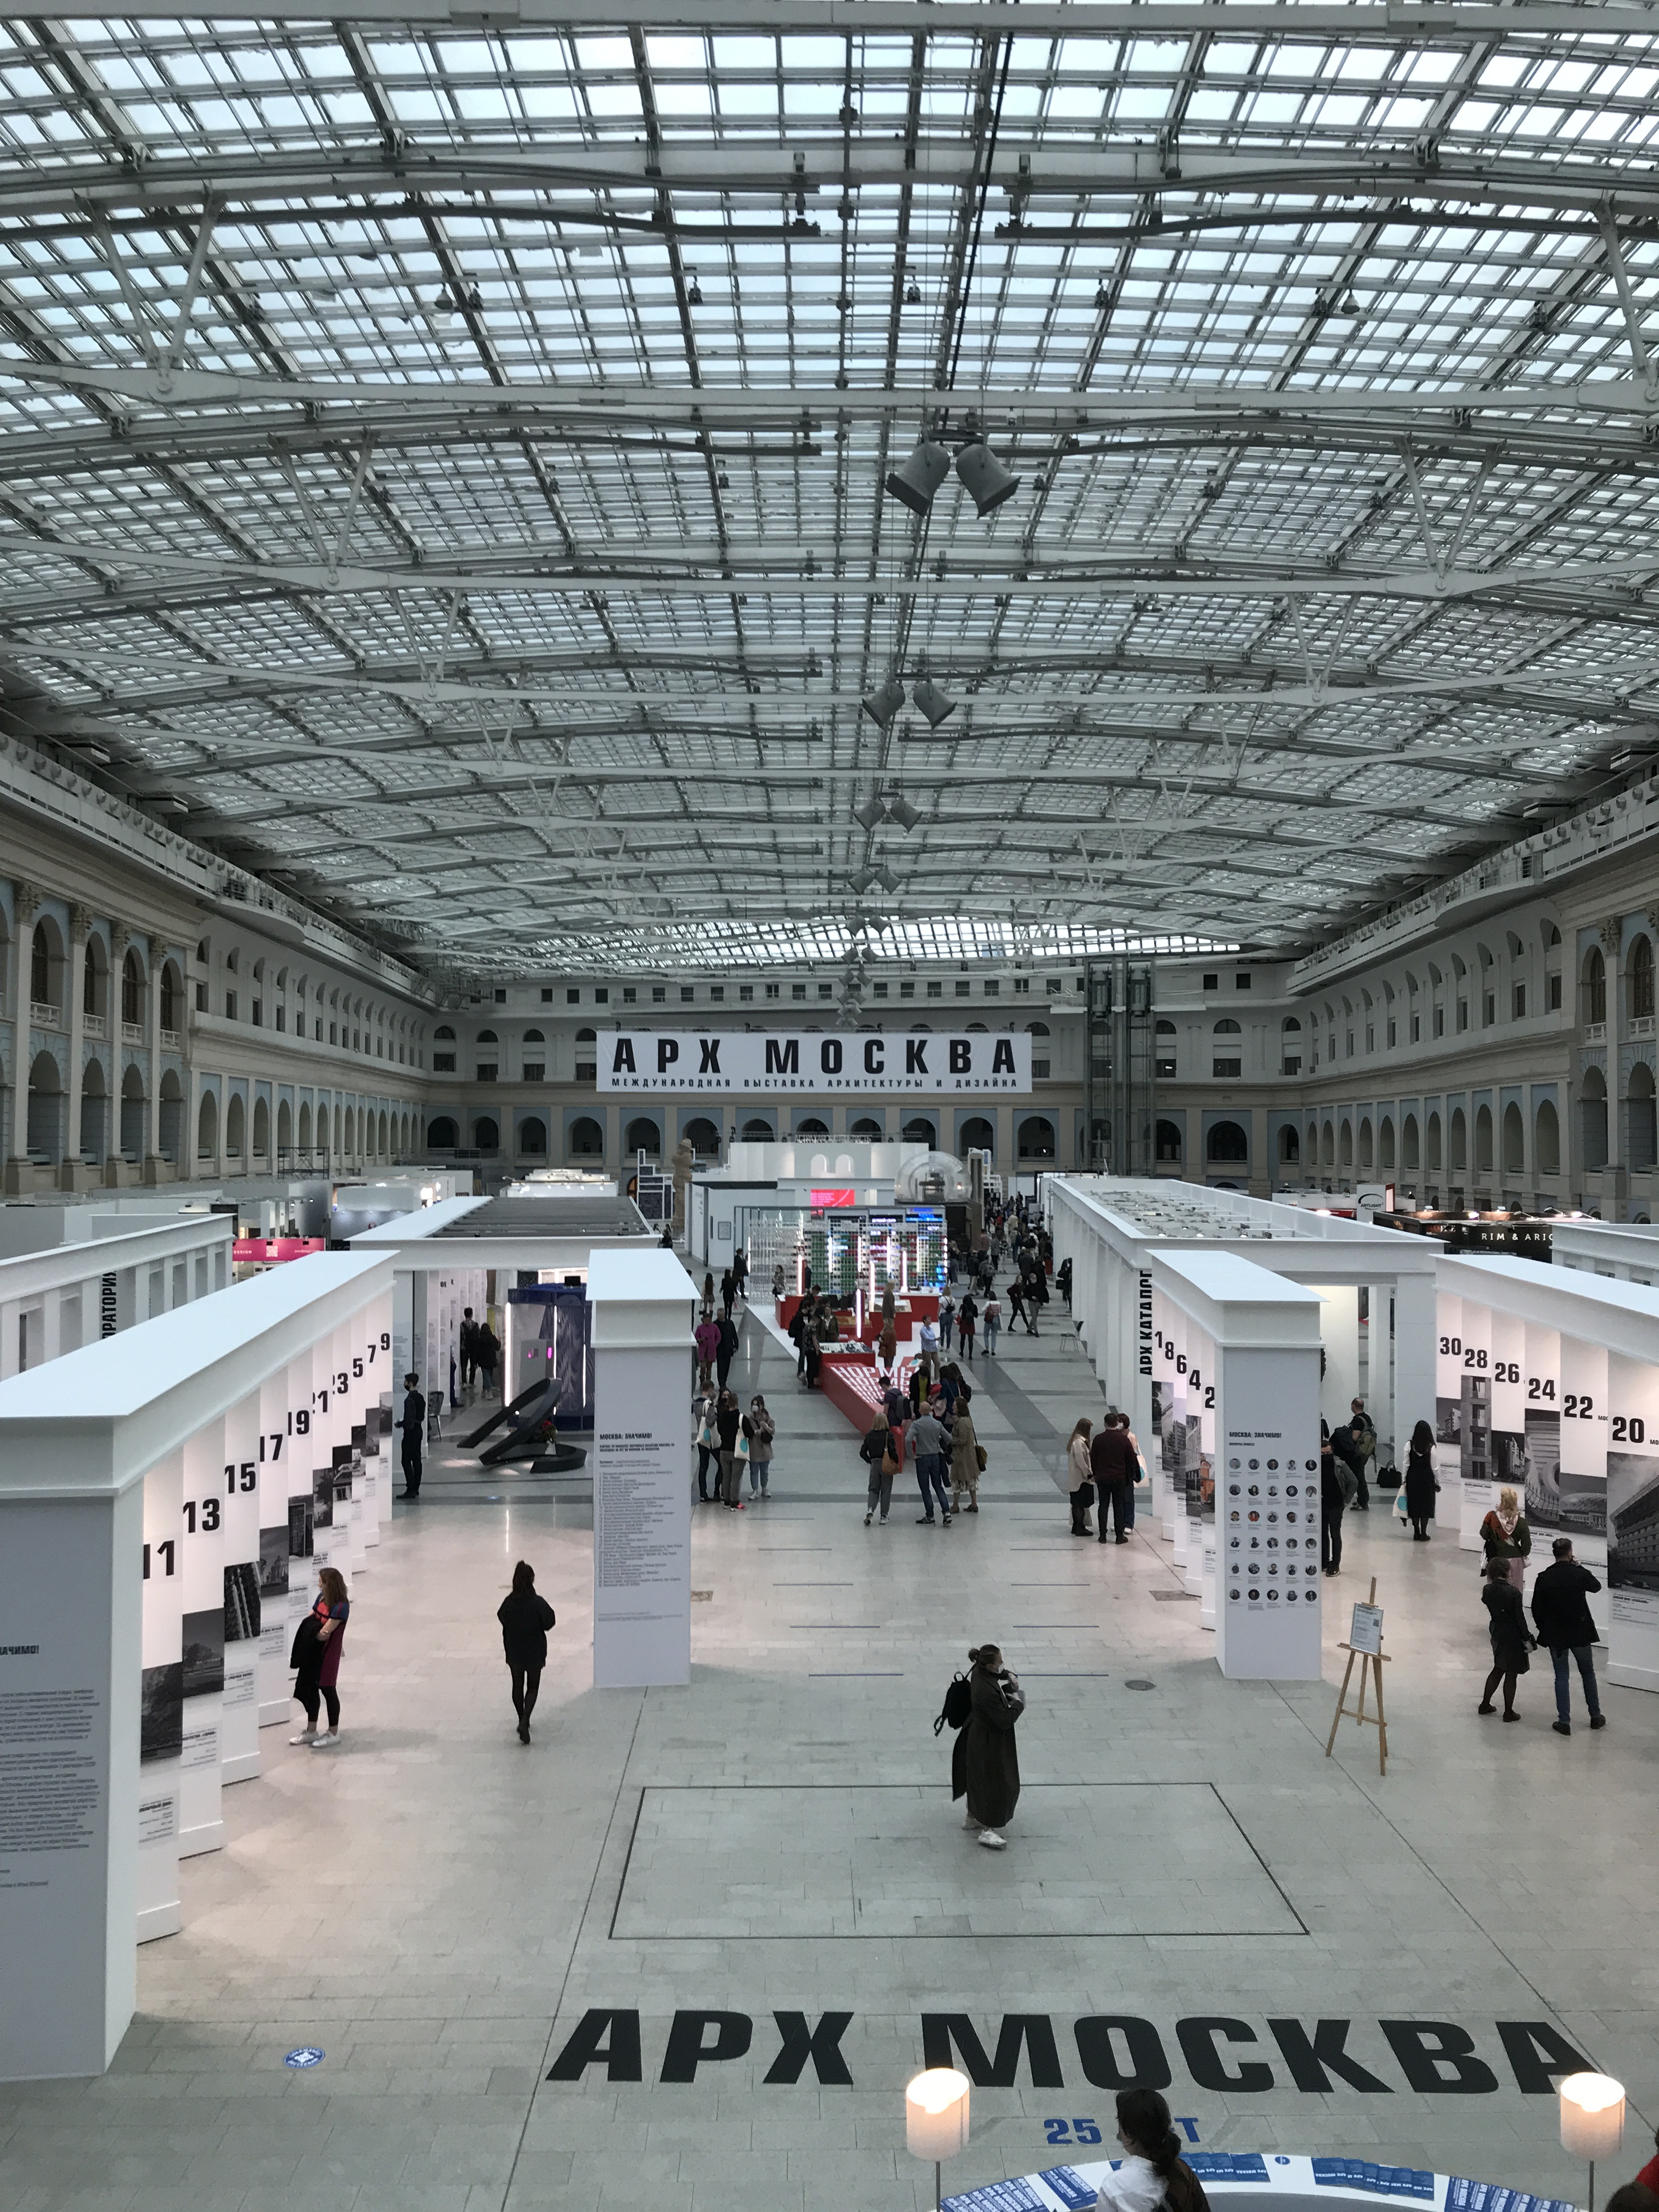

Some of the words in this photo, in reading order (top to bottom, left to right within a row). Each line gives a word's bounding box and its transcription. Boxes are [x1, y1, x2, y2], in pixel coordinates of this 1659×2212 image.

[612, 1038, 721, 1074] АРХ
[765, 1039, 1016, 1074] МОСКВА
[612, 1077, 731, 1088] МЕЖДУНАРОДНАЯ
[744, 1079, 814, 1088] ВЫСТАВКА
[827, 1079, 923, 1088] АРХИТЕКТУРЫ
[936, 1079, 943, 1087] И
[956, 1077, 1017, 1089] ДИЗАЙНА
[1165, 1341, 1174, 1360] 8
[1440, 1336, 1462, 1356] 30
[1139, 1346, 1152, 1375] АРХ
[1177, 1355, 1187, 1374] 6
[1464, 1348, 1488, 1369] 28
[1189, 1369, 1201, 1390] 4
[1494, 1362, 1520, 1384] 26
[1205, 1386, 1215, 1409] 2
[1528, 1378, 1556, 1401] 24
[1564, 1395, 1593, 1419] 22
[1612, 1417, 1645, 1443] 20
[224, 1462, 256, 1494] 15
[183, 1498, 220, 1533] 13
[545, 2008, 855, 2085] АРХ
[919, 2013, 1602, 2095] МОСКВА
[1043, 2119, 1103, 2145] 25
